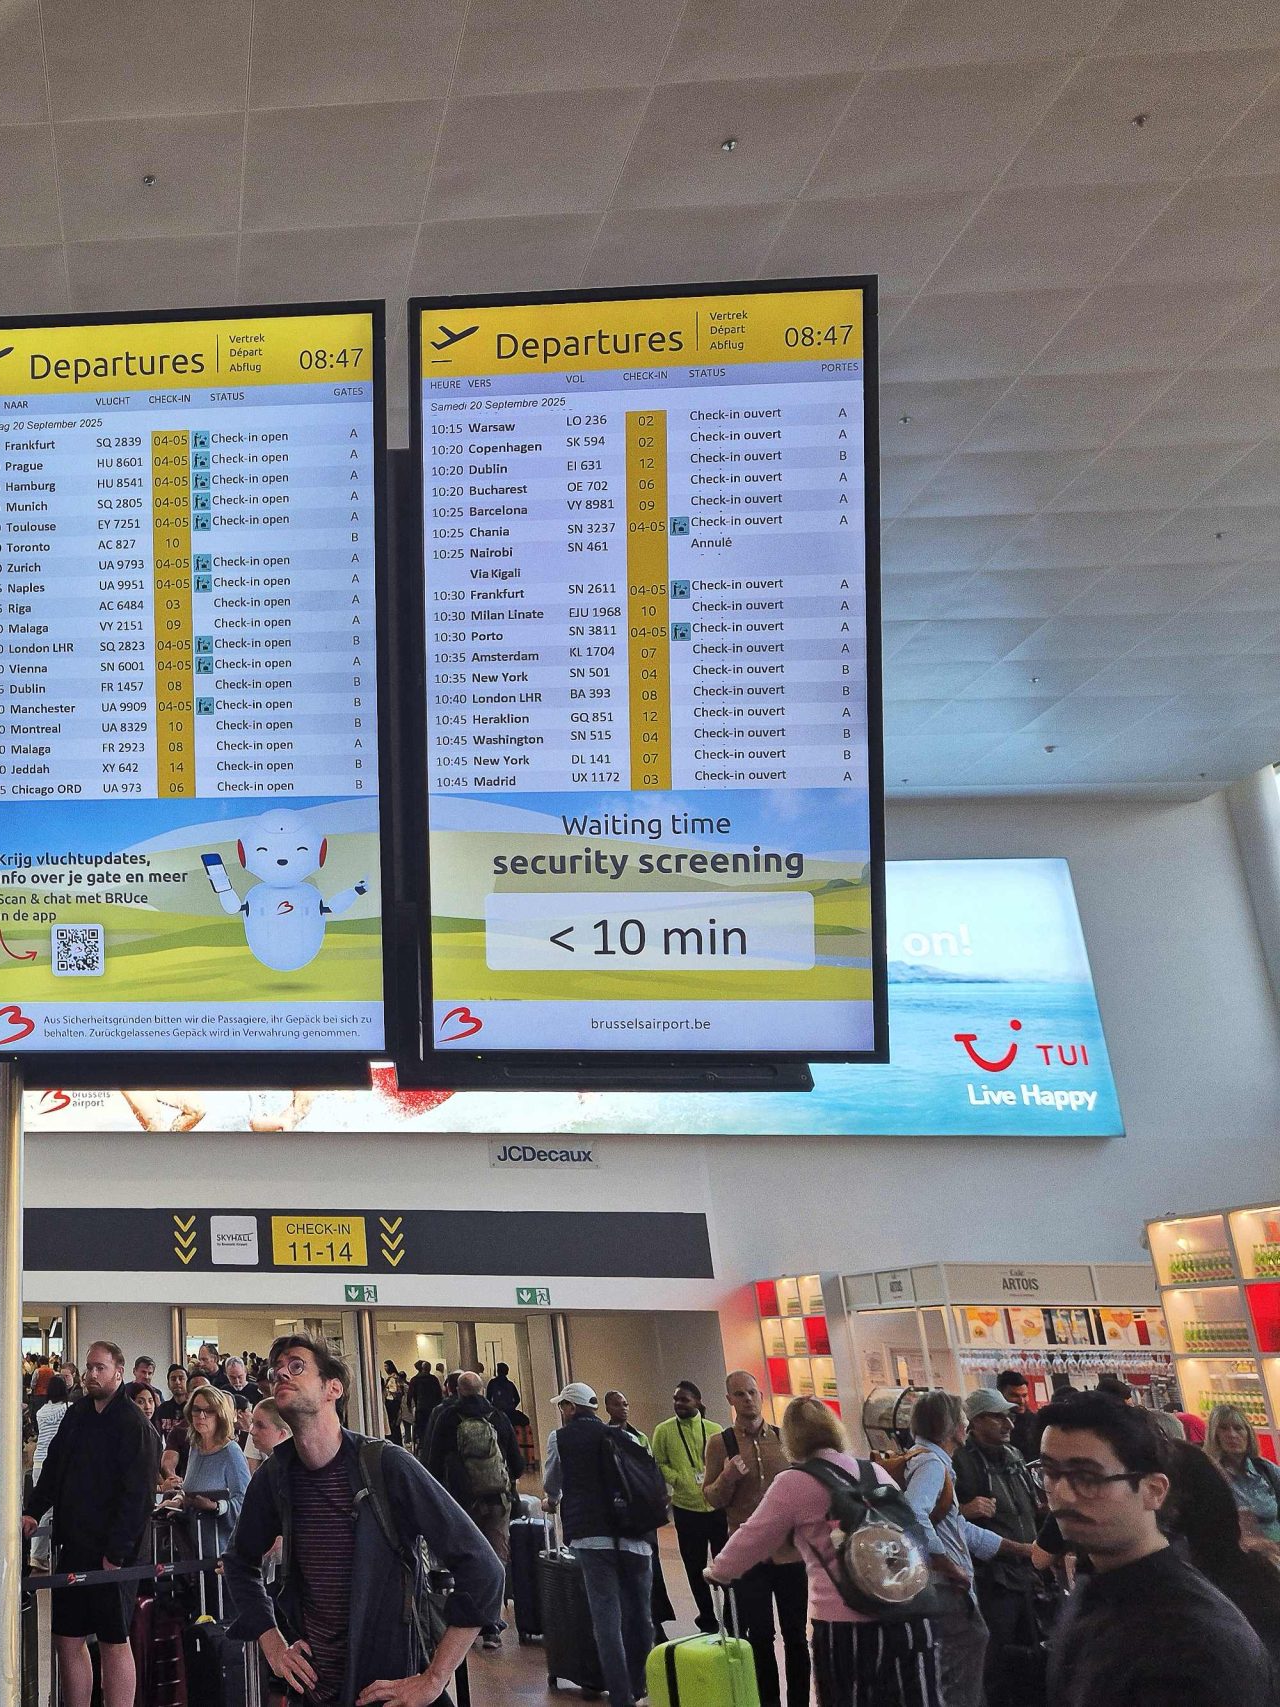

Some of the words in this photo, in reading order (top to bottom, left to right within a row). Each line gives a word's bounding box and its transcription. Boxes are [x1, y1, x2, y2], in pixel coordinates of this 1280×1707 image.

[709, 309, 748, 321] Vertrek
[228, 332, 265, 344] Vertrek
[710, 324, 746, 336] Départ
[784, 324, 853, 347] 08:47
[229, 347, 263, 358] Départ
[496, 329, 683, 364] Departures
[709, 339, 744, 351] Abflug
[30, 351, 204, 384] Departures
[229, 362, 261, 373] Abflug
[299, 348, 363, 370] 08:47
[430, 379, 461, 389] HEURE
[467, 378, 491, 388] VERS
[565, 374, 585, 383] VOL
[622, 370, 668, 381] CHECK-IN
[688, 368, 726, 378] STATUS
[821, 362, 859, 372] PORTES
[430, 401, 467, 411] Samedi
[469, 400, 483, 410] 20
[484, 398, 538, 410] Septembre
[541, 396, 566, 408] 2025
[431, 423, 462, 434] 10:15
[468, 422, 516, 433] Warsaw
[566, 415, 582, 426] LO
[584, 414, 607, 425] 236
[638, 415, 654, 426] 02
[689, 409, 740, 420] Check-in
[743, 408, 781, 419] ouvert
[838, 407, 847, 418] A
[10, 763, 50, 774] Jeddah
[102, 763, 115, 773] XY
[118, 762, 138, 772] 642
[169, 762, 184, 772] 14
[216, 760, 263, 771] Check-in
[266, 762, 293, 772] open
[355, 758, 362, 768] B
[561, 813, 662, 839] Waiting
[671, 812, 730, 834] time
[36, 851, 150, 868] vluchtupdates,
[493, 846, 629, 880] security
[638, 845, 804, 879] screening
[30, 873, 65, 884] over
[67, 869, 82, 886] je
[86, 870, 121, 886] gate
[125, 873, 144, 883] en
[148, 872, 188, 883] meer
[30, 893, 40, 904] &
[43, 892, 72, 904] chat
[75, 892, 102, 904] met
[105, 892, 148, 904] BRUce
[12, 909, 28, 921] de
[32, 912, 56, 923] app
[549, 926, 574, 952] <
[593, 918, 646, 955] 10
[663, 918, 746, 955] min
[903, 923, 972, 957] on!
[591, 1017, 710, 1032] brusselsairport.be
[1035, 1044, 1089, 1066] TUI
[72, 1099, 105, 1109] airport
[967, 1083, 1017, 1106] Live
[1020, 1083, 1098, 1111] Happy
[497, 1145, 593, 1163] JCDecaux
[216, 1232, 254, 1243] SKYHALL
[286, 1223, 351, 1235] CHECK-IN
[288, 1242, 353, 1263] 11-14
[1002, 1278, 1039, 1291] ARTOIS
